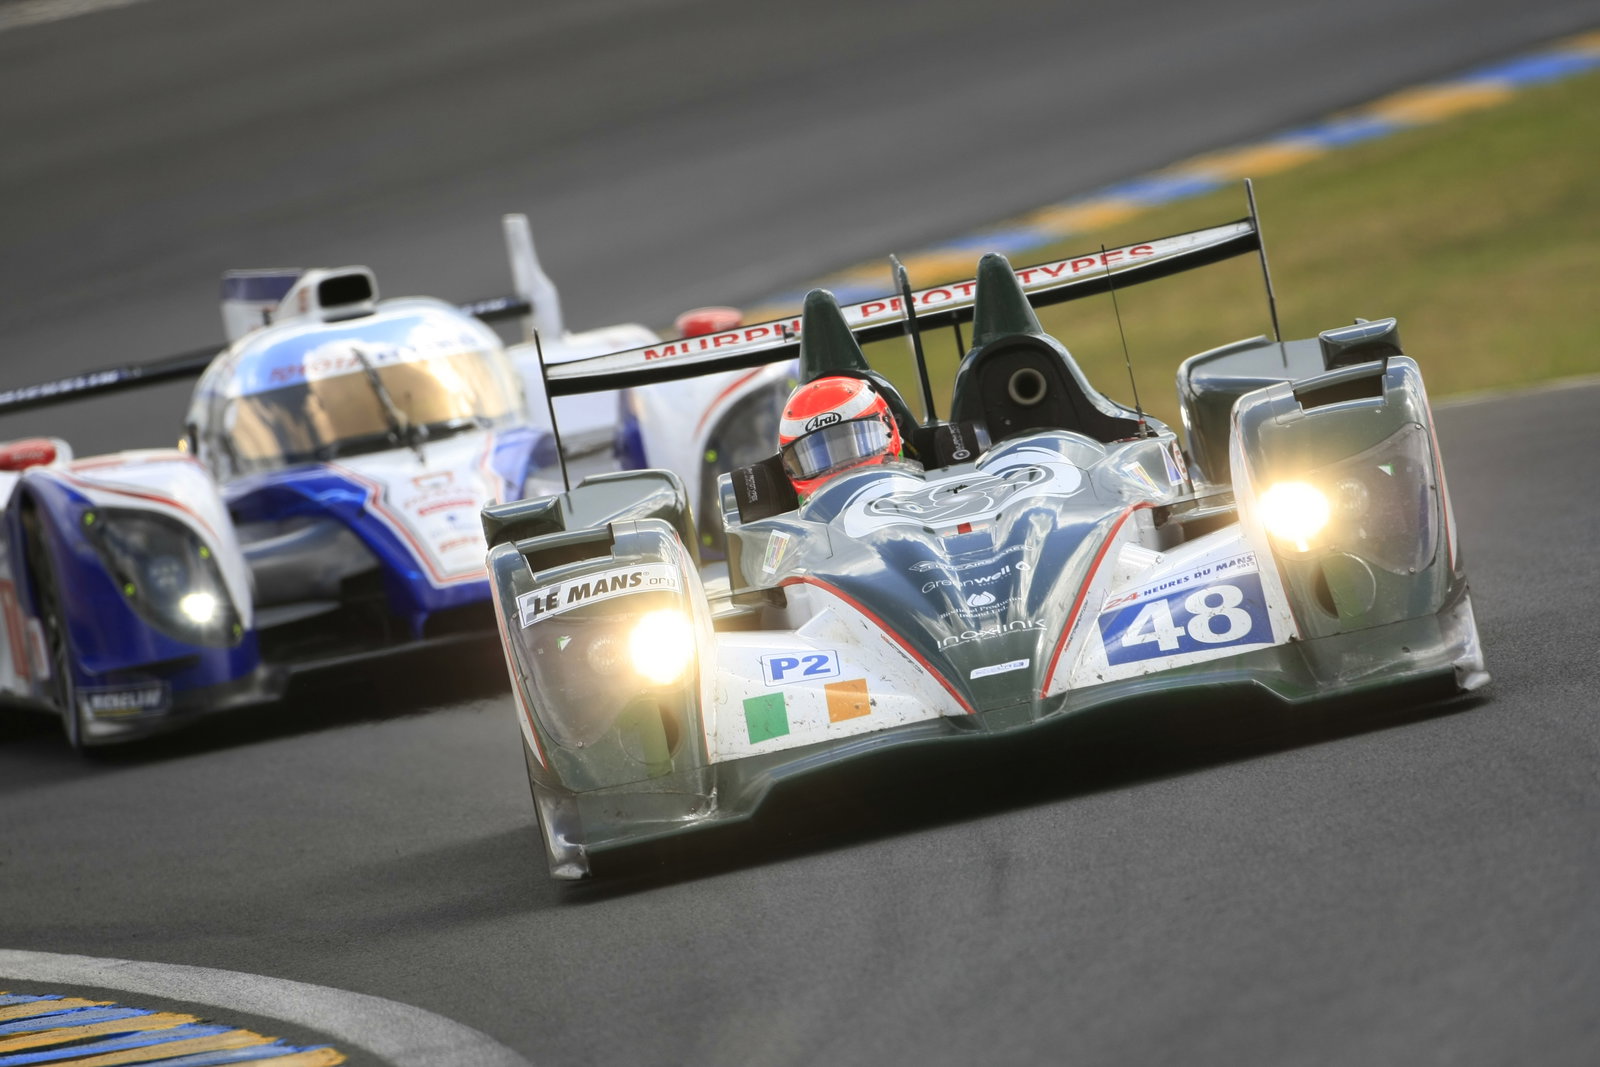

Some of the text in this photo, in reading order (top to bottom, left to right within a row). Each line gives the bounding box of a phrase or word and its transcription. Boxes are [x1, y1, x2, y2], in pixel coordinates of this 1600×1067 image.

[643, 245, 1154, 361] MURPH PROTTYPES
[921, 565, 1011, 594] Greenwell
[1103, 554, 1255, 611] 24 HEURES DU MANS
[533, 592, 560, 616] LE
[1121, 584, 1252, 652] 48
[769, 654, 832, 681] P2
